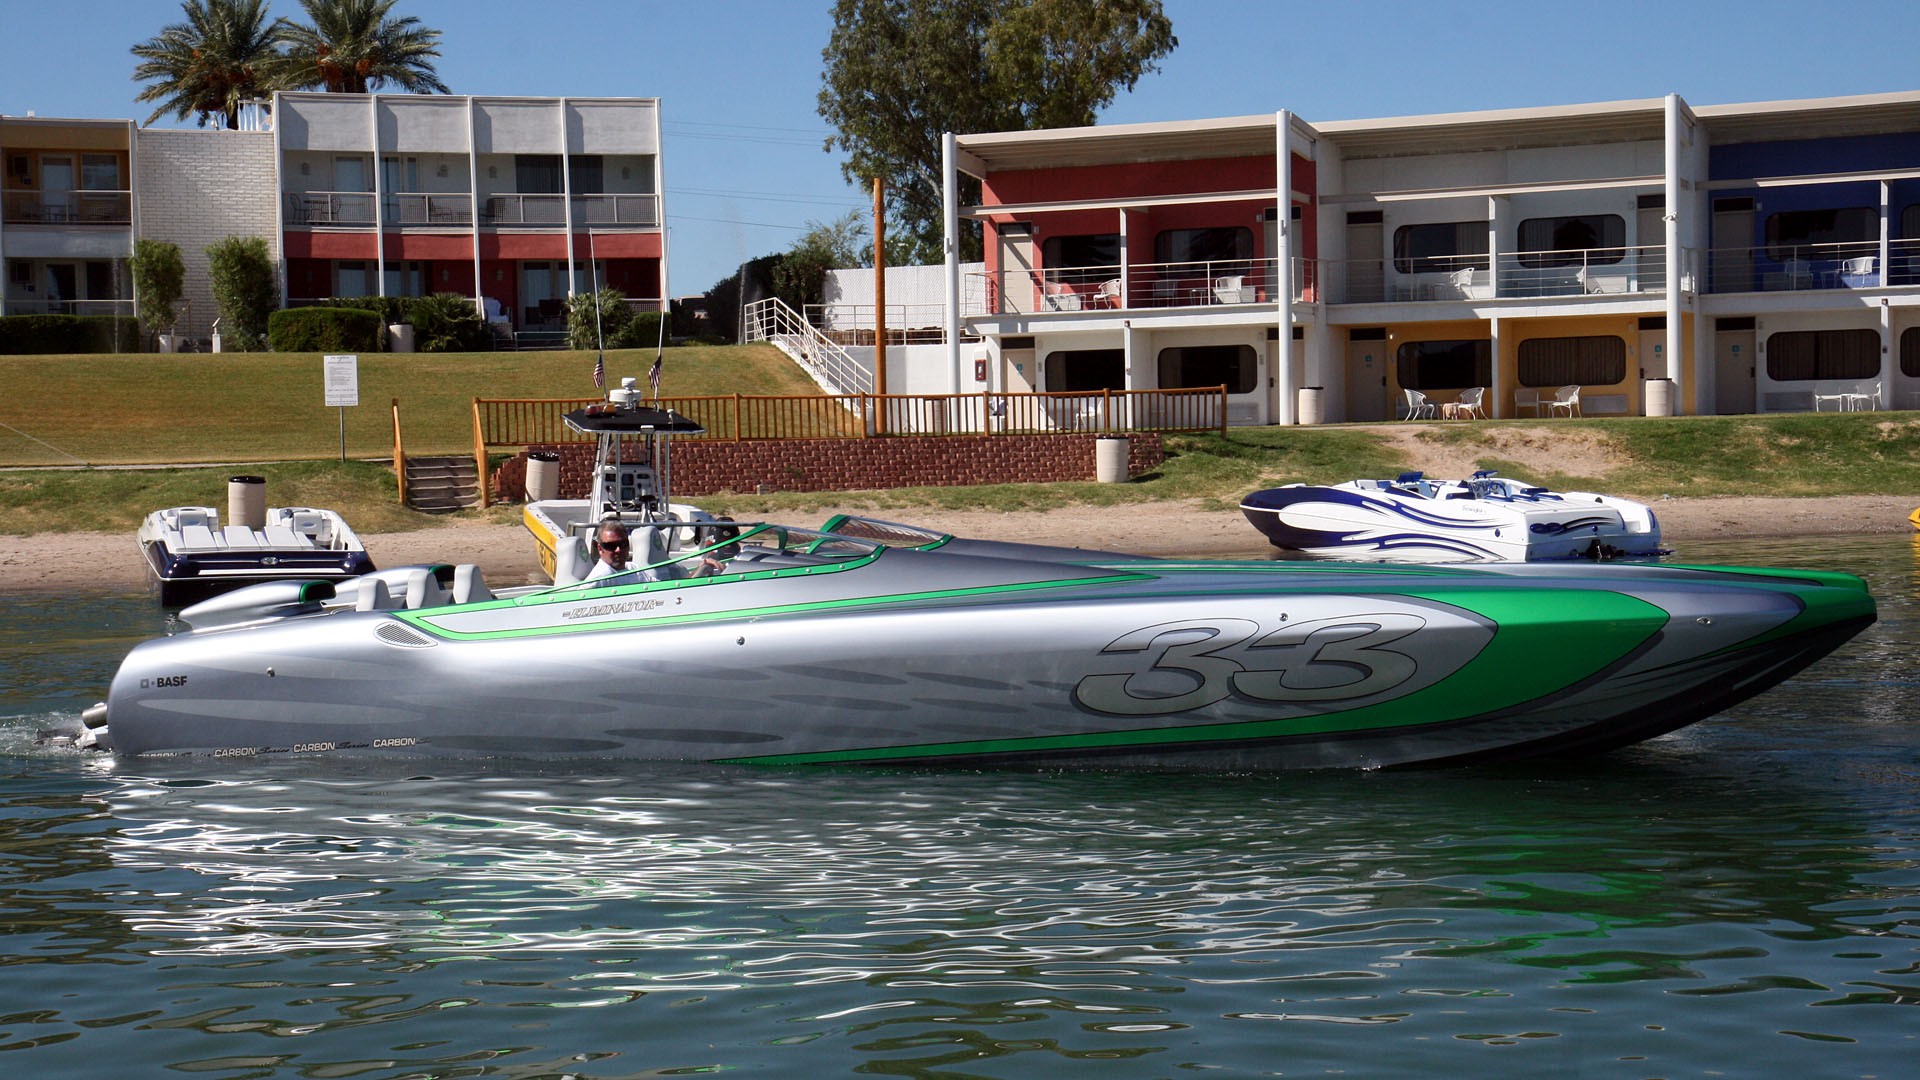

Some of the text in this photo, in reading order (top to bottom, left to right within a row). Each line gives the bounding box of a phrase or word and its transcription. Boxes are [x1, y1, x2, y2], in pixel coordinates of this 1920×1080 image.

[568, 599, 657, 619] ELIMINATOR
[1074, 613, 1427, 716] 33
[157, 676, 187, 687] BASF
[214, 747, 256, 757] CARBON
[293, 742, 336, 752] CARBON
[373, 737, 416, 748] CARBON
